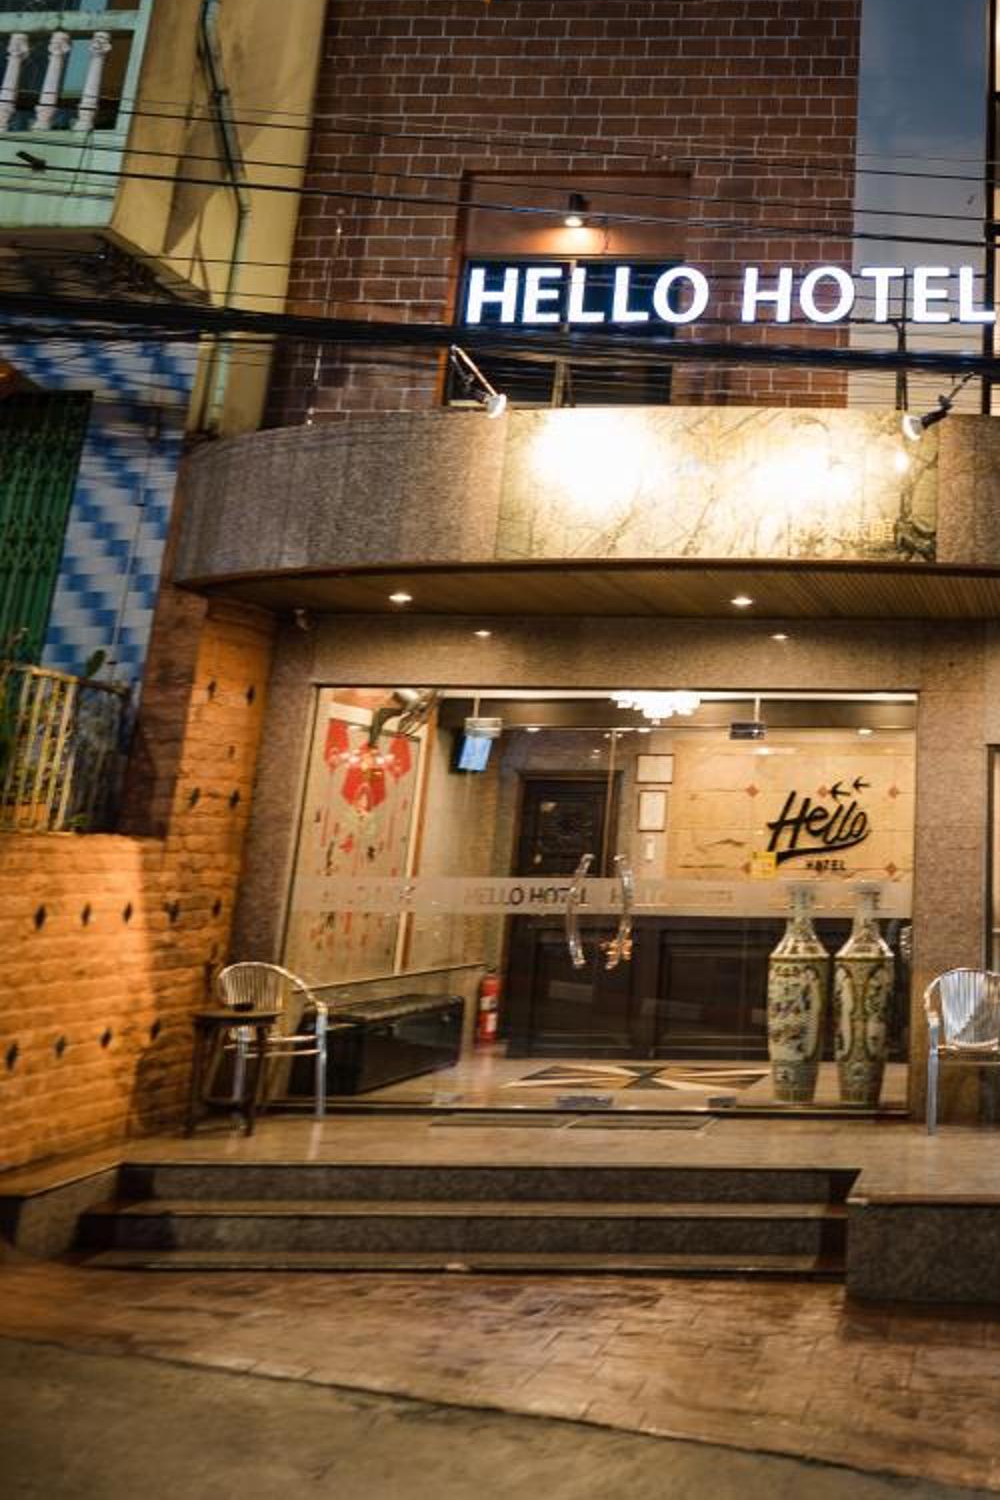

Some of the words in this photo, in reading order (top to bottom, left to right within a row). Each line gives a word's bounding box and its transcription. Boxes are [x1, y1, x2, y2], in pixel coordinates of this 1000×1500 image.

[465, 266, 710, 323] HELLO
[741, 266, 997, 323] HOTEL
[767, 790, 869, 852] Hello
